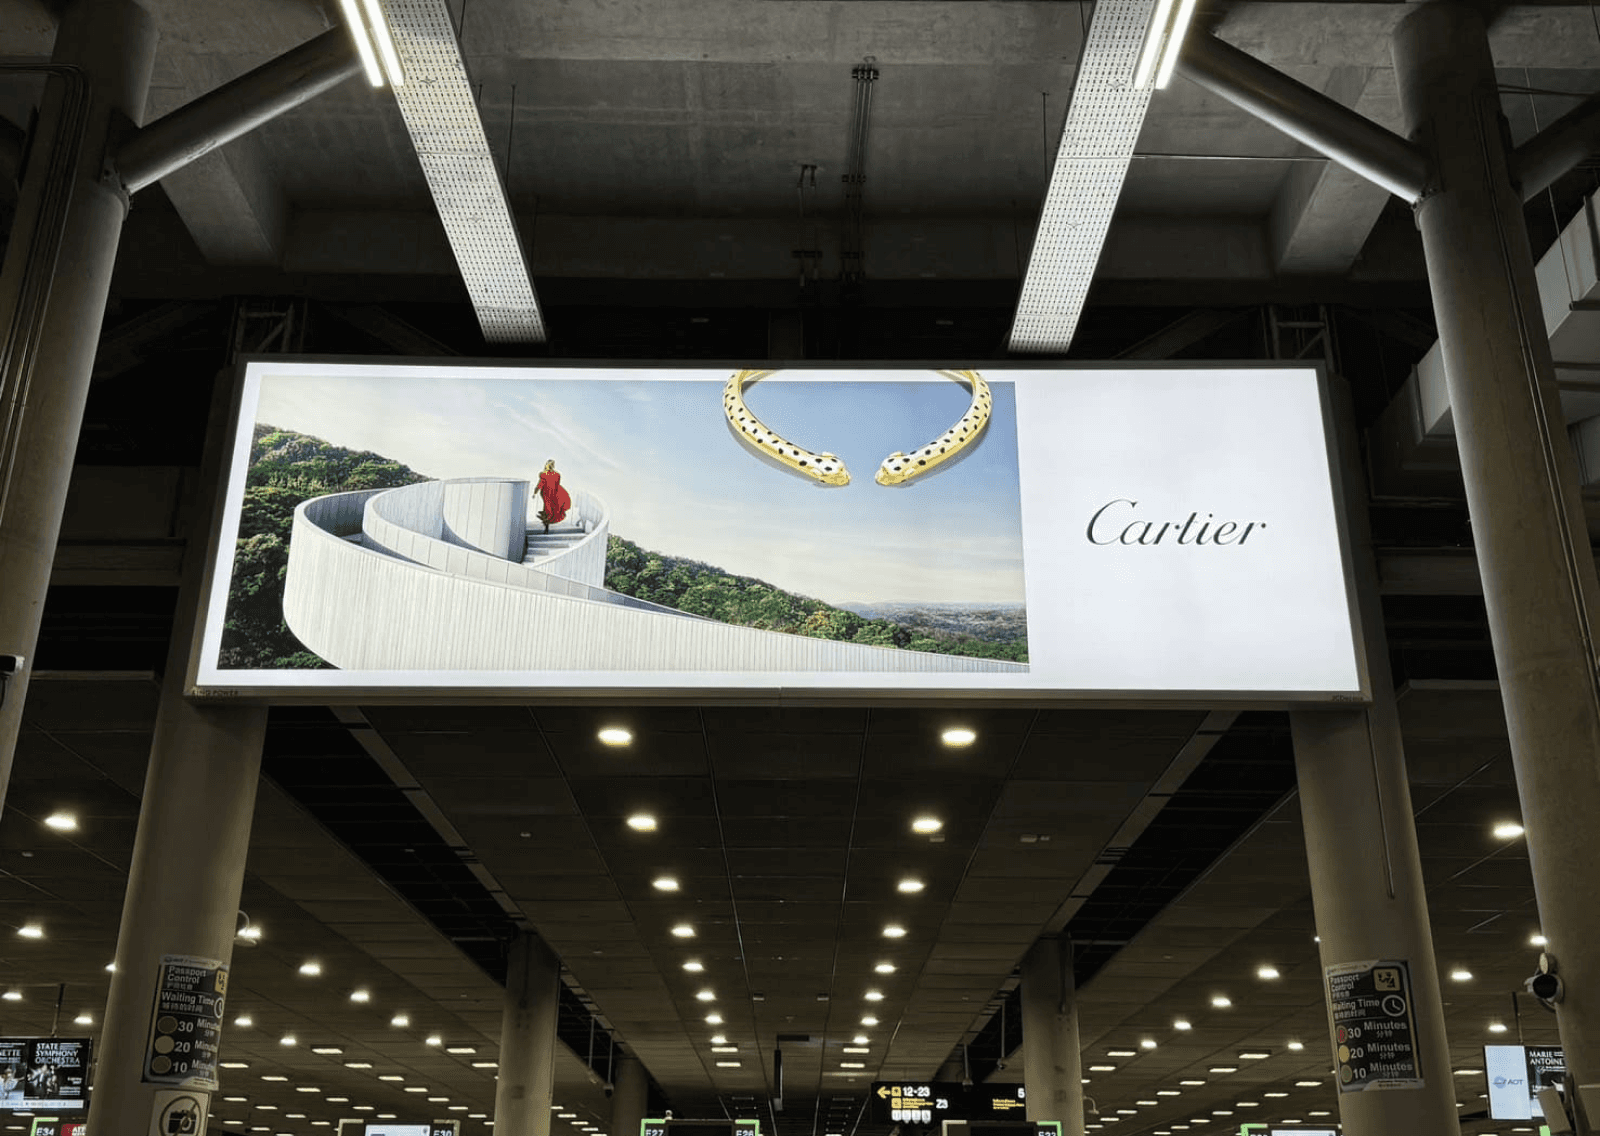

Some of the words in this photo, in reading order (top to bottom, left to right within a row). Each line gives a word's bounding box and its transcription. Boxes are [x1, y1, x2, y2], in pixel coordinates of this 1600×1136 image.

[1086, 498, 1267, 546] Cartier
[169, 965, 207, 978] Passport
[167, 973, 200, 984] Control
[1331, 981, 1354, 992] Control
[162, 991, 196, 1004] Waiting
[198, 994, 214, 1006] Time
[1358, 998, 1380, 1008] Time
[178, 1021, 194, 1032] 30
[1347, 1027, 1362, 1039] 30
[1363, 1021, 1407, 1031] Minutes
[174, 1041, 191, 1053] 20
[1350, 1047, 1364, 1059] 20
[1367, 1043, 1411, 1053] Minutes
[35, 1056, 80, 1064] ORCHESTRA
[173, 1062, 188, 1073] 10
[1353, 1067, 1367, 1079] 10
[1369, 1062, 1413, 1072] Minutes
[902, 1086, 931, 1097] 12-23
[36, 1127, 55, 1136] E34
